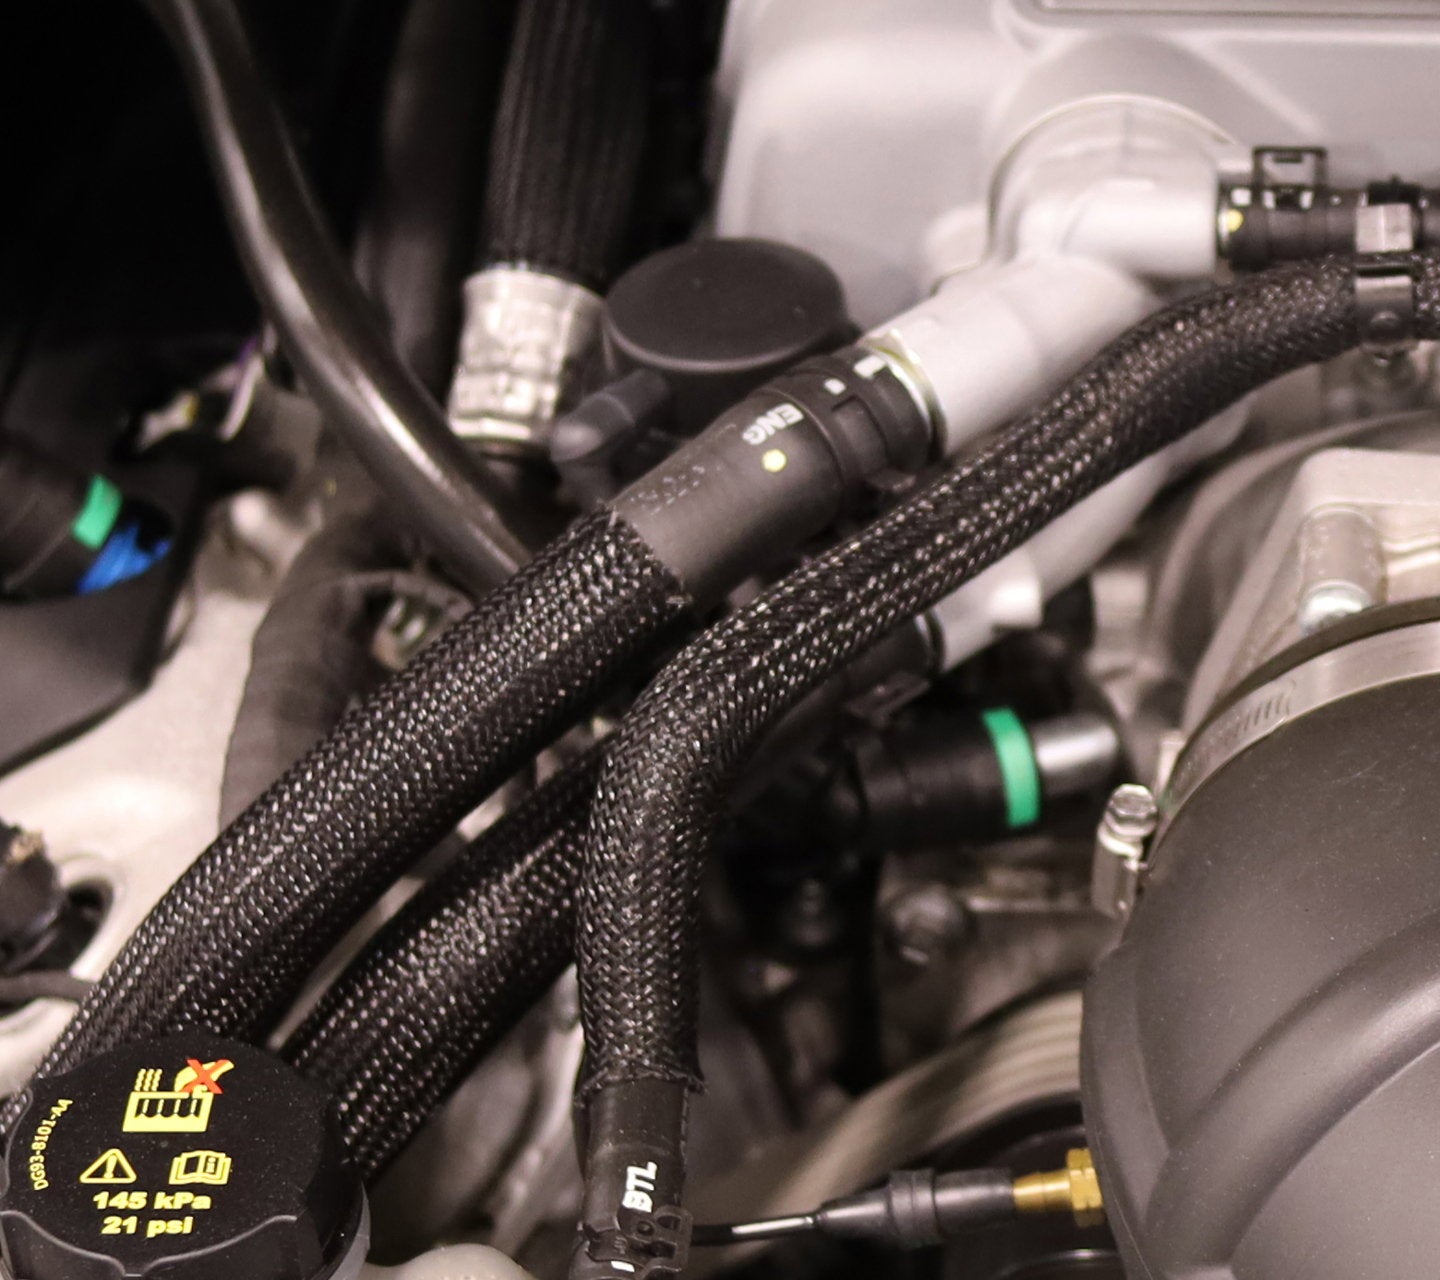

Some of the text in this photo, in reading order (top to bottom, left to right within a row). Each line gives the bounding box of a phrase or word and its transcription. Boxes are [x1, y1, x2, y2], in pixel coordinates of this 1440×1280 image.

[742, 402, 805, 446] ENG
[92, 1191, 212, 1211] 145 kPa
[101, 1215, 194, 1239] 21 psi
